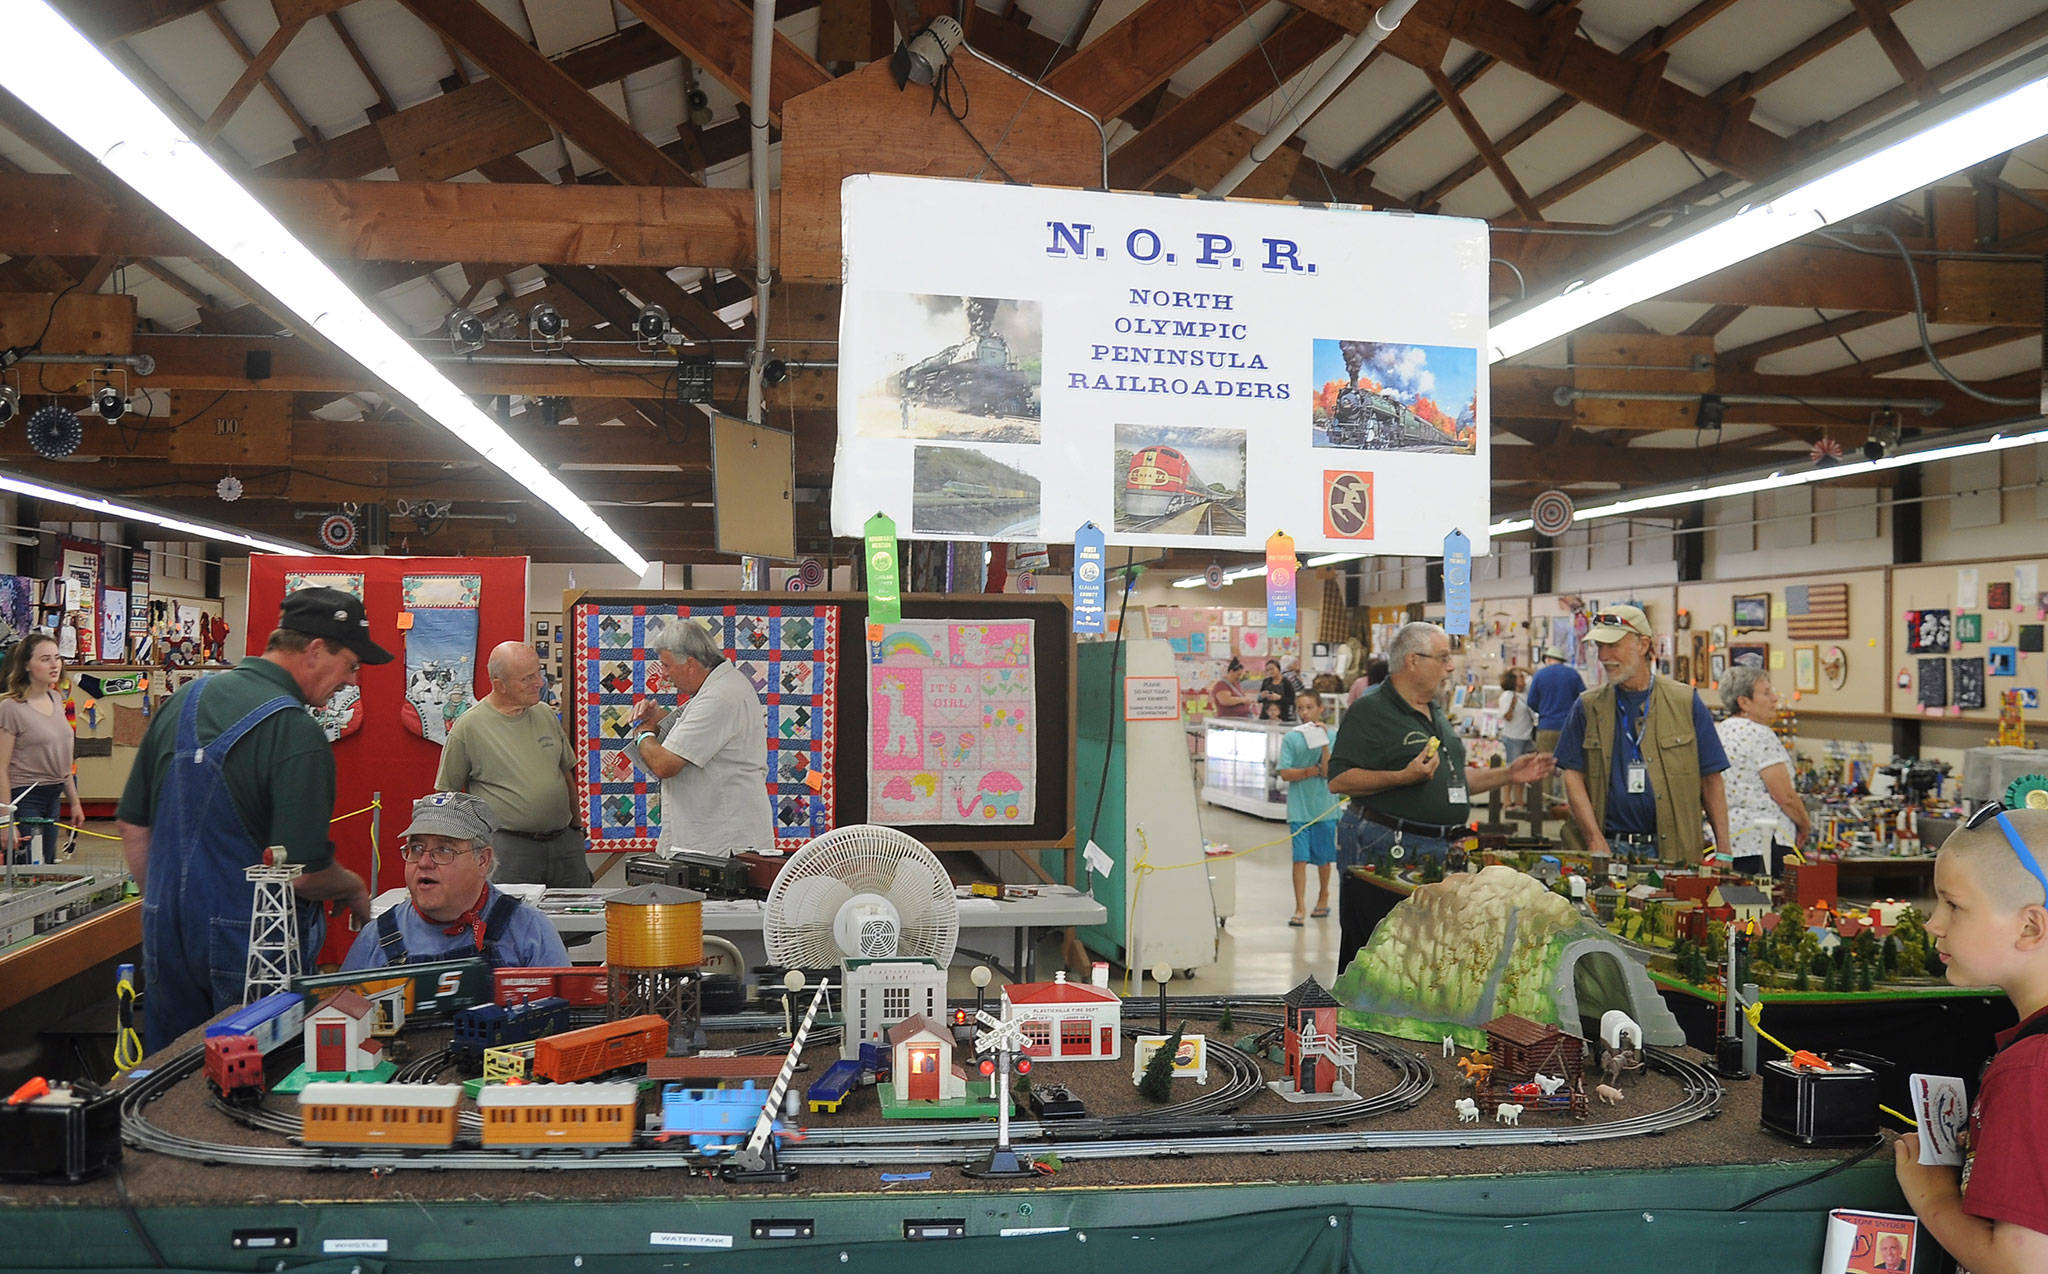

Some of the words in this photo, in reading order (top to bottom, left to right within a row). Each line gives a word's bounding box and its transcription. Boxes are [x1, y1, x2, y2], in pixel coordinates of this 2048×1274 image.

[1046, 221, 1106, 258] N.
[1126, 228, 1176, 263] O.
[1196, 232, 1242, 268] P.
[1261, 237, 1318, 273] R.
[1129, 288, 1234, 311] NORTH
[1115, 316, 1247, 341] OLYMPIC
[1091, 344, 1269, 370] PENINSULA
[1068, 372, 1291, 400] RAILROADERS
[929, 683, 958, 694] IT'S
[964, 683, 973, 694] A
[934, 698, 968, 709] GIRL
[977, 1012, 996, 1028] RAIL
[1010, 1031, 1031, 1046] ROAD
[978, 1012, 1031, 1046] CROSSING
